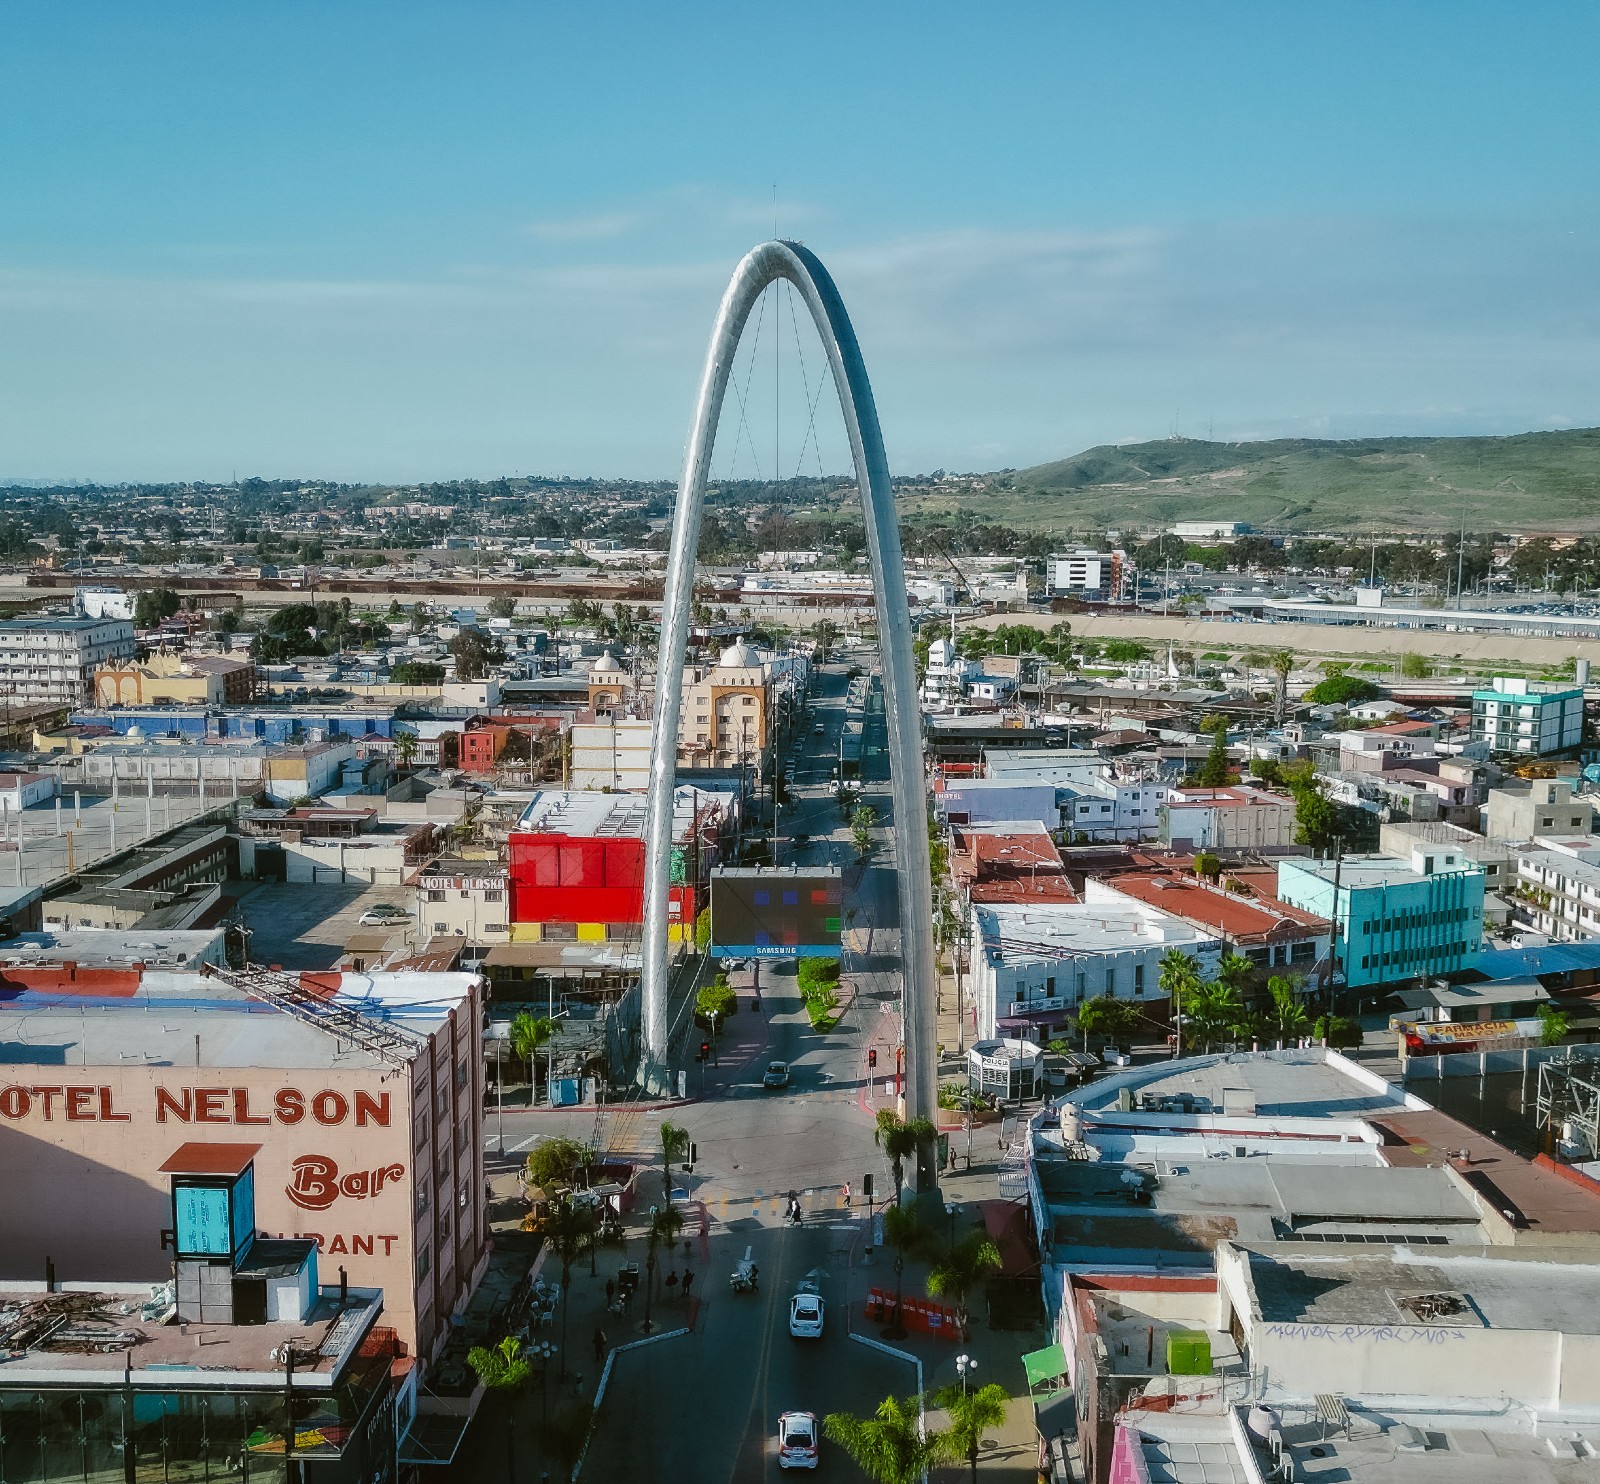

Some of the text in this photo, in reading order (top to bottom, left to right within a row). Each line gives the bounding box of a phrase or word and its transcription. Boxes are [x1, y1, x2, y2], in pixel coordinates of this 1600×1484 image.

[420, 878, 505, 890] MOTEL ALASKA
[1434, 1021, 1508, 1034] FARMACIA
[1453, 1030, 1495, 1038] MAYO
[982, 1057, 1009, 1066] POLICIA
[155, 1086, 392, 1128] NELSON
[285, 1153, 406, 1211] Bar
[161, 1228, 399, 1257] RRANT
